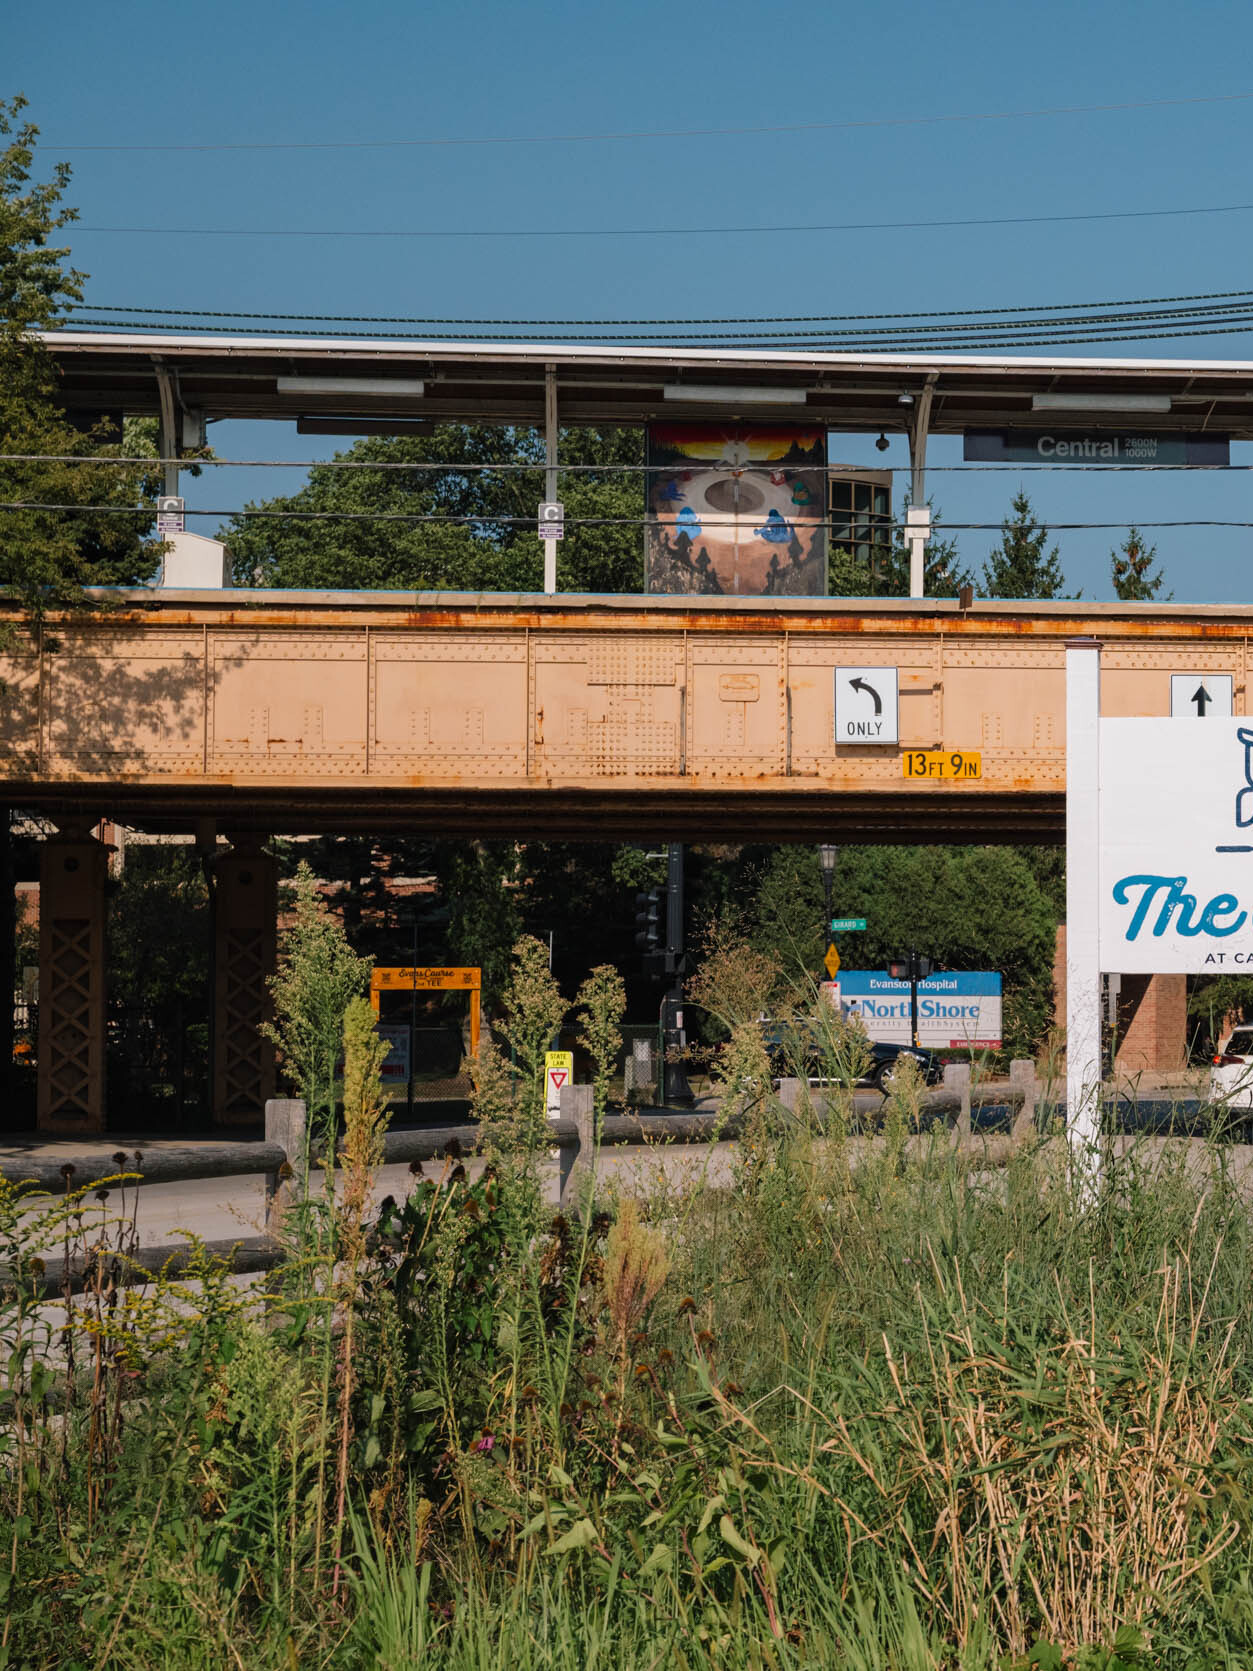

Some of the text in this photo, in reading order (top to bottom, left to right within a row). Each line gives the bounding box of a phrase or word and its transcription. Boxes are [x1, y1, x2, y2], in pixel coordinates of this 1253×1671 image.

[1037, 436, 1119, 457] Central
[1125, 438, 1158, 447] 2600N
[1126, 448, 1157, 457] 1000W
[544, 506, 558, 521] C
[847, 721, 882, 736] ONLY
[1112, 874, 1248, 941] The
[1205, 952, 1228, 964] AT
[918, 979, 958, 991] Hospital
